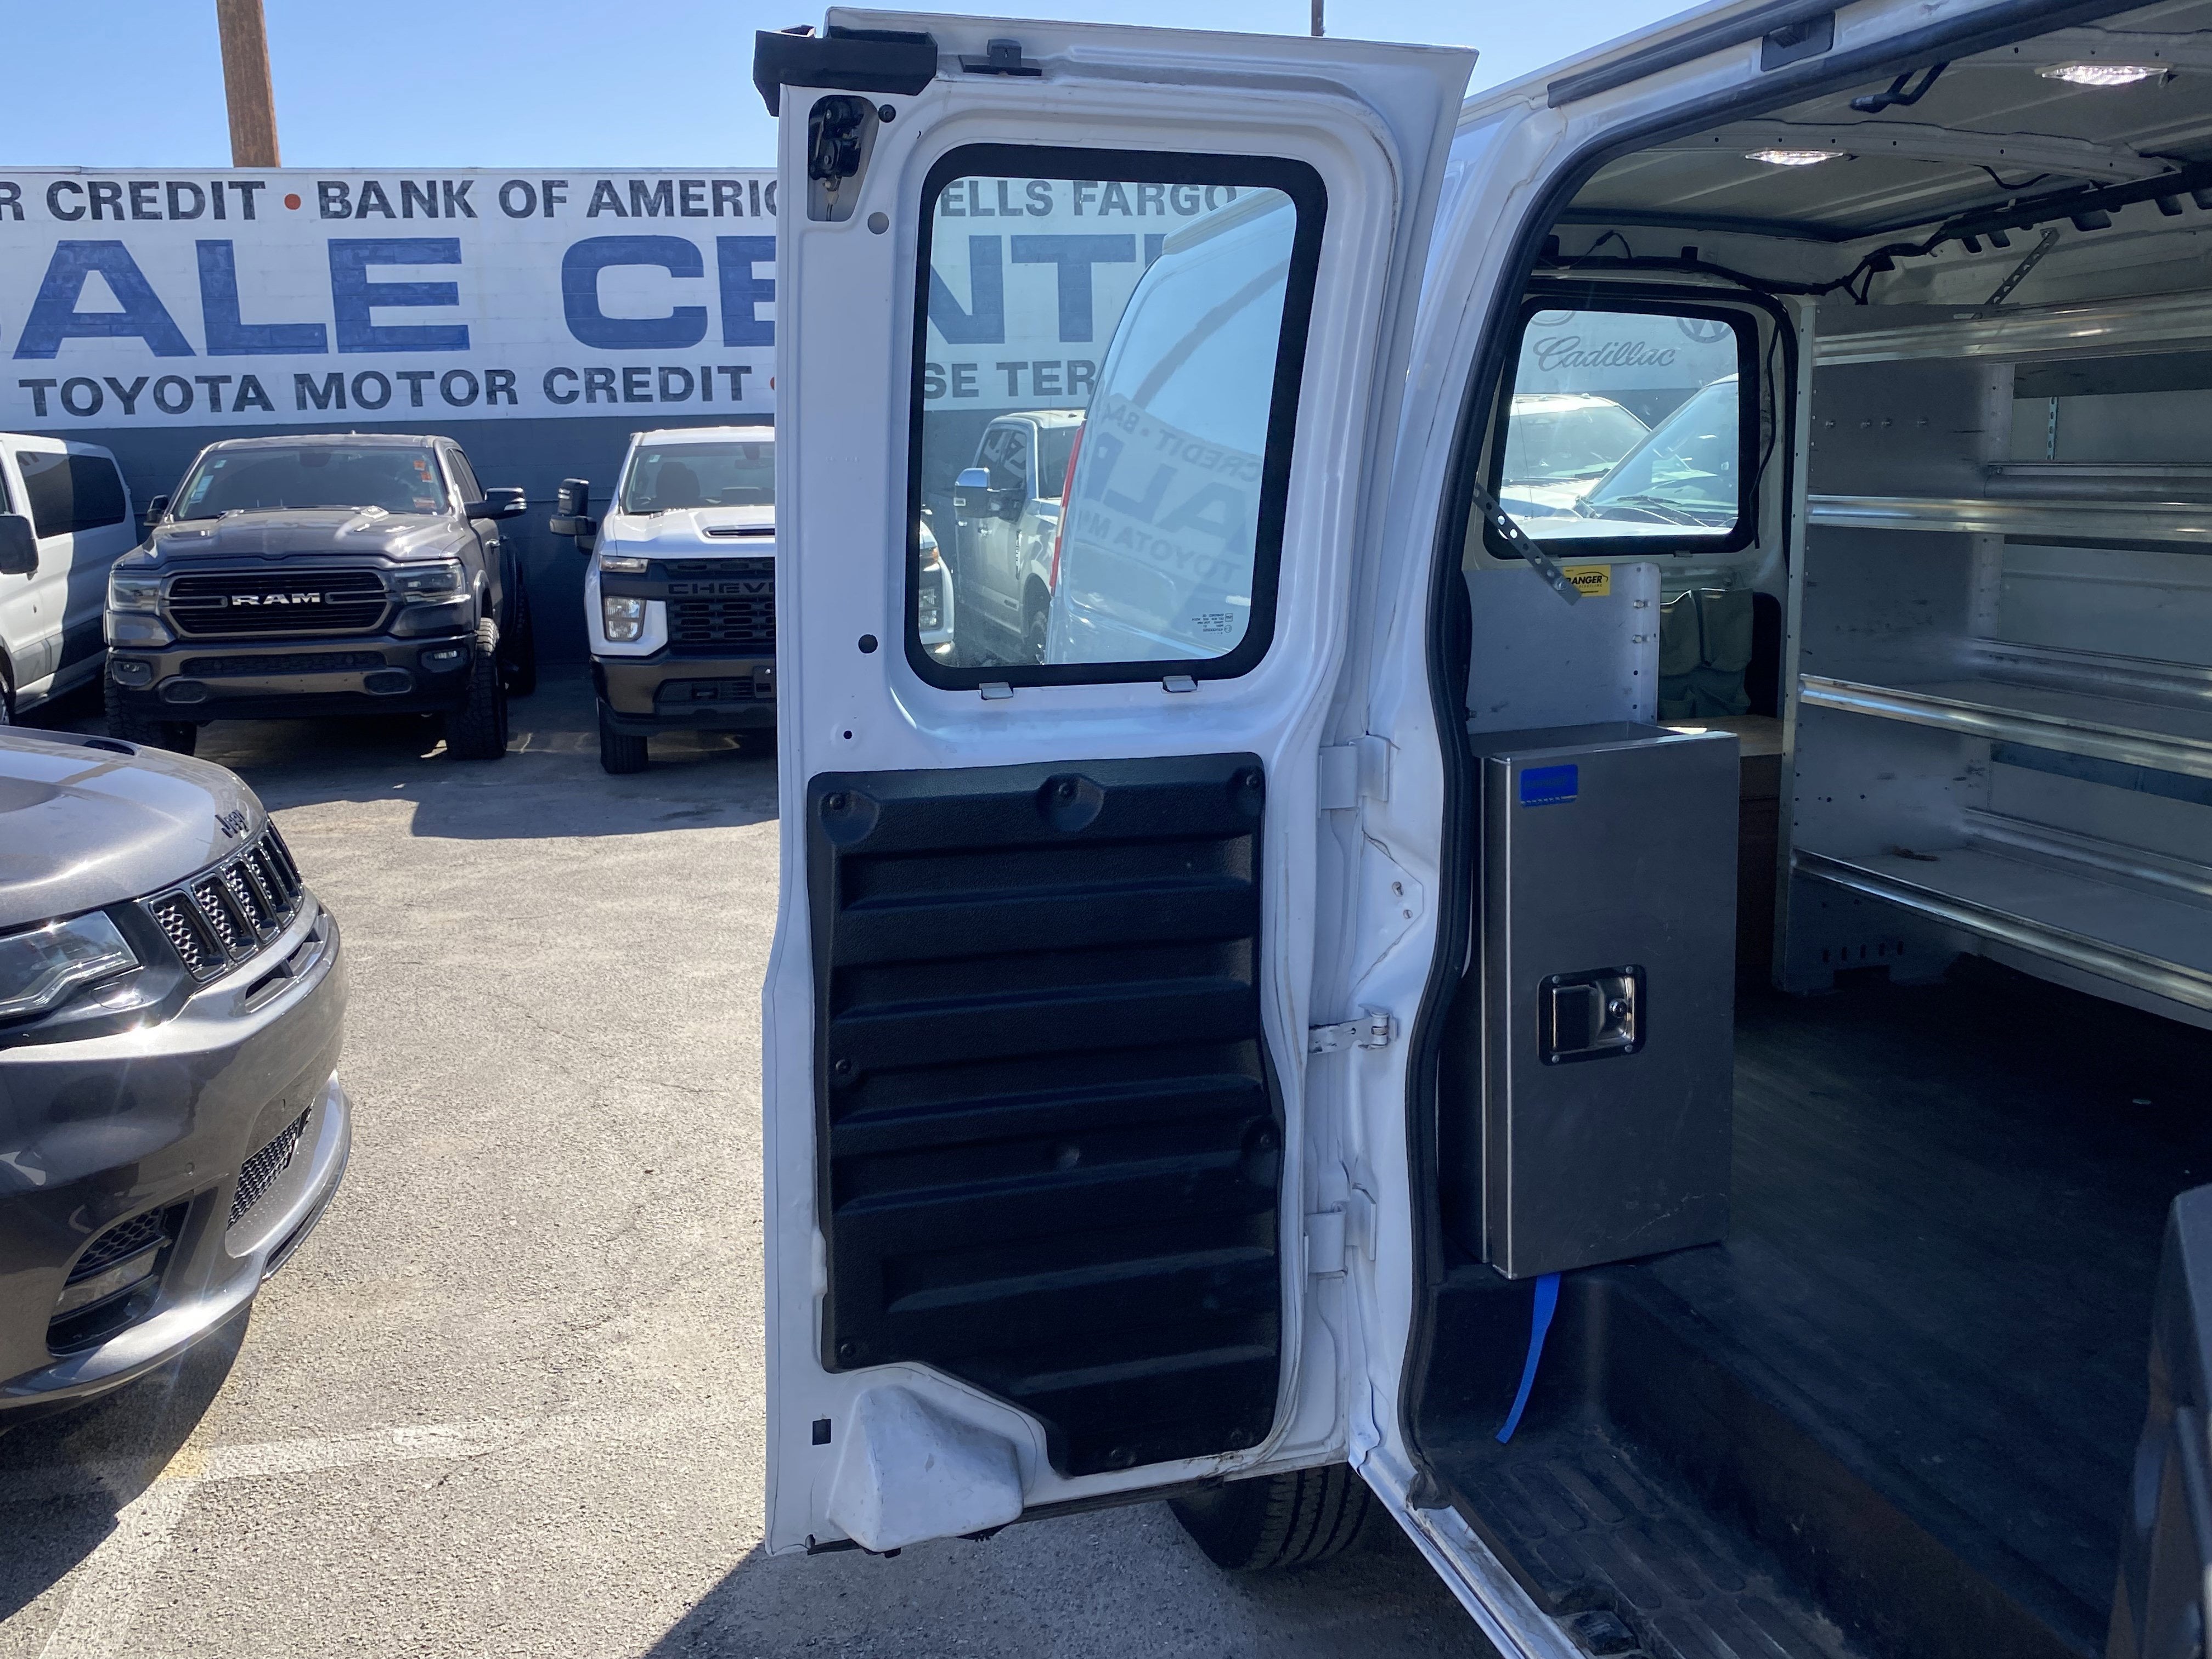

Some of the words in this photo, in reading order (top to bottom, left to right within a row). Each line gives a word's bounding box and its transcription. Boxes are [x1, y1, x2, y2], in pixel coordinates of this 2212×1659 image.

[46, 180, 266, 221] CREDIT
[317, 179, 477, 219] BANK
[498, 179, 568, 218] OF
[1073, 180, 1237, 217] FARGO
[1533, 336, 1677, 372] Cadillac
[18, 375, 275, 417] TOYOTA
[293, 369, 518, 411] MOTOR
[543, 365, 752, 405] CREDIT
[232, 593, 320, 606] RAM
[668, 583, 774, 594] CHEV
[215, 810, 249, 838] Jeep
